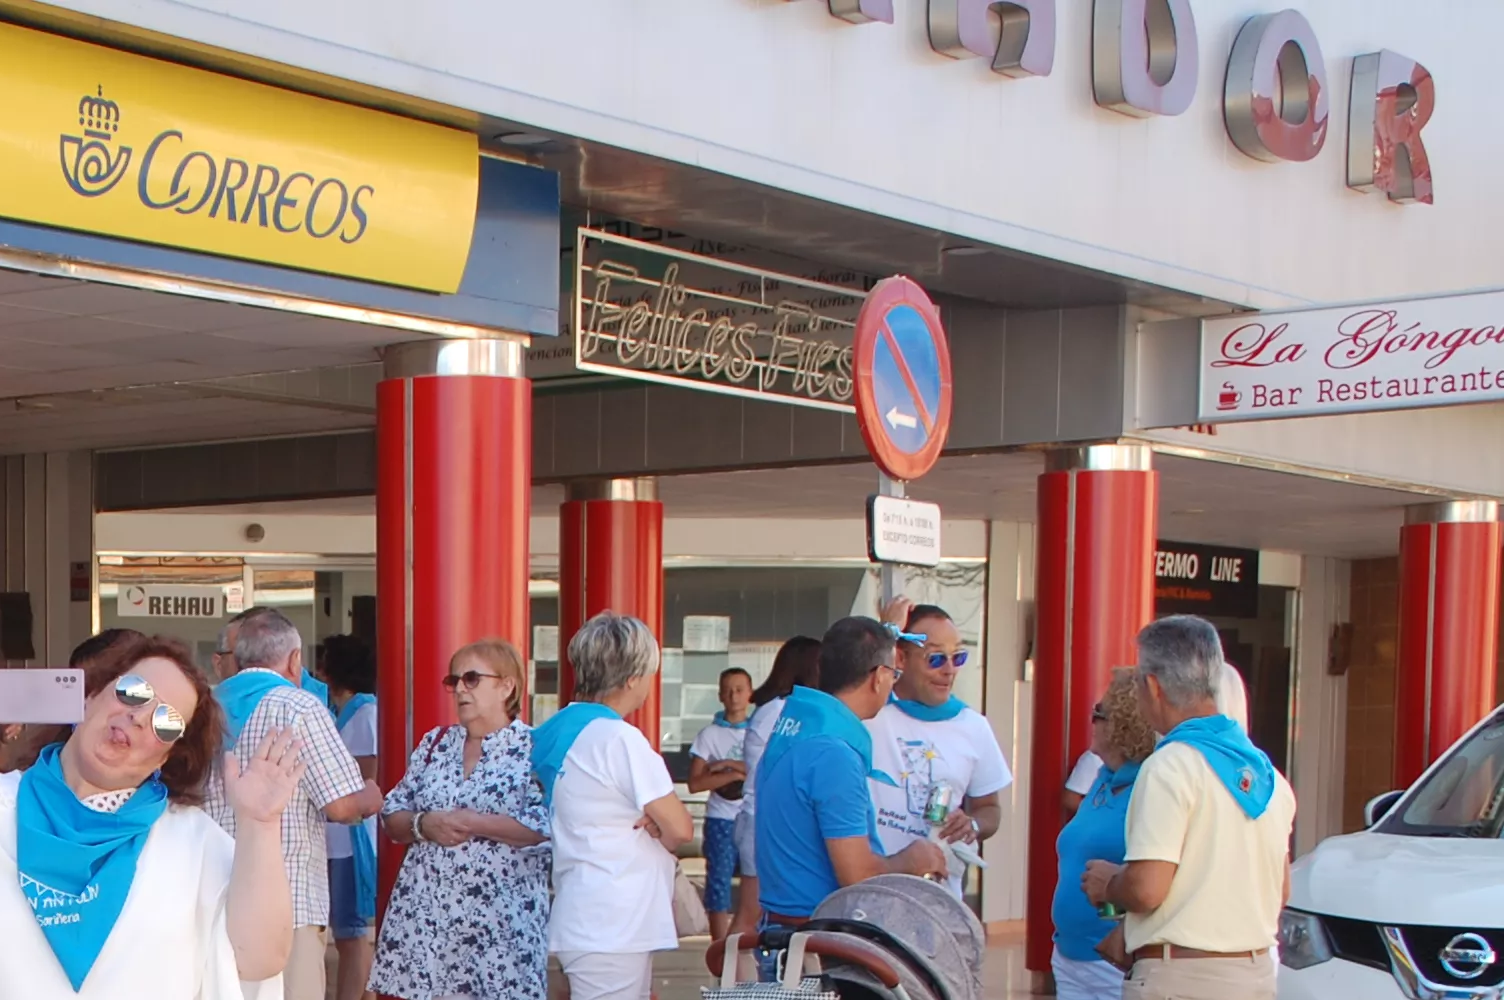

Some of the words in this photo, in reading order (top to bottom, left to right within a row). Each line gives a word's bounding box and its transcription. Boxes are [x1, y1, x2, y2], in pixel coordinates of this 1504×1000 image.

[137, 129, 374, 244] CORREOS
[581, 262, 757, 384] Felices
[1210, 323, 1307, 368] La
[1252, 384, 1302, 408] Bar
[1210, 556, 1243, 583] LINE
[148, 596, 214, 617] REHAU
